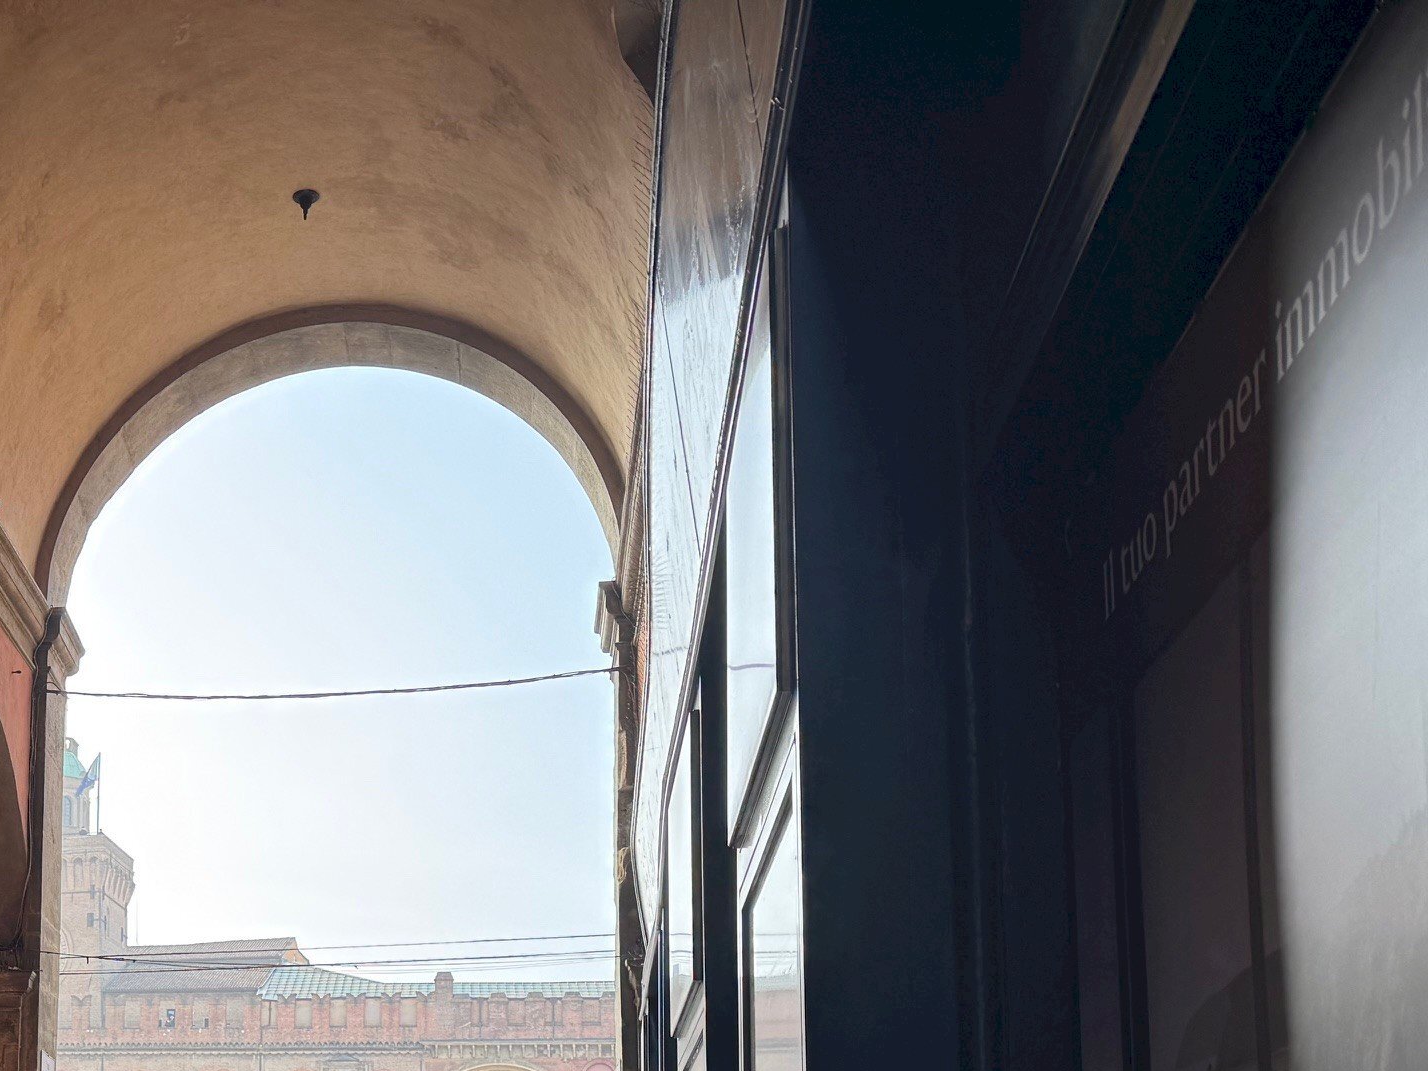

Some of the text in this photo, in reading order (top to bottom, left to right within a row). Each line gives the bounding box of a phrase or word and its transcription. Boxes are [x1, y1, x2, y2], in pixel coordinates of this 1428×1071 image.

[1120, 511, 1158, 595] tuo
[1162, 347, 1269, 560] partner
[1275, 72, 1428, 383] immobil
